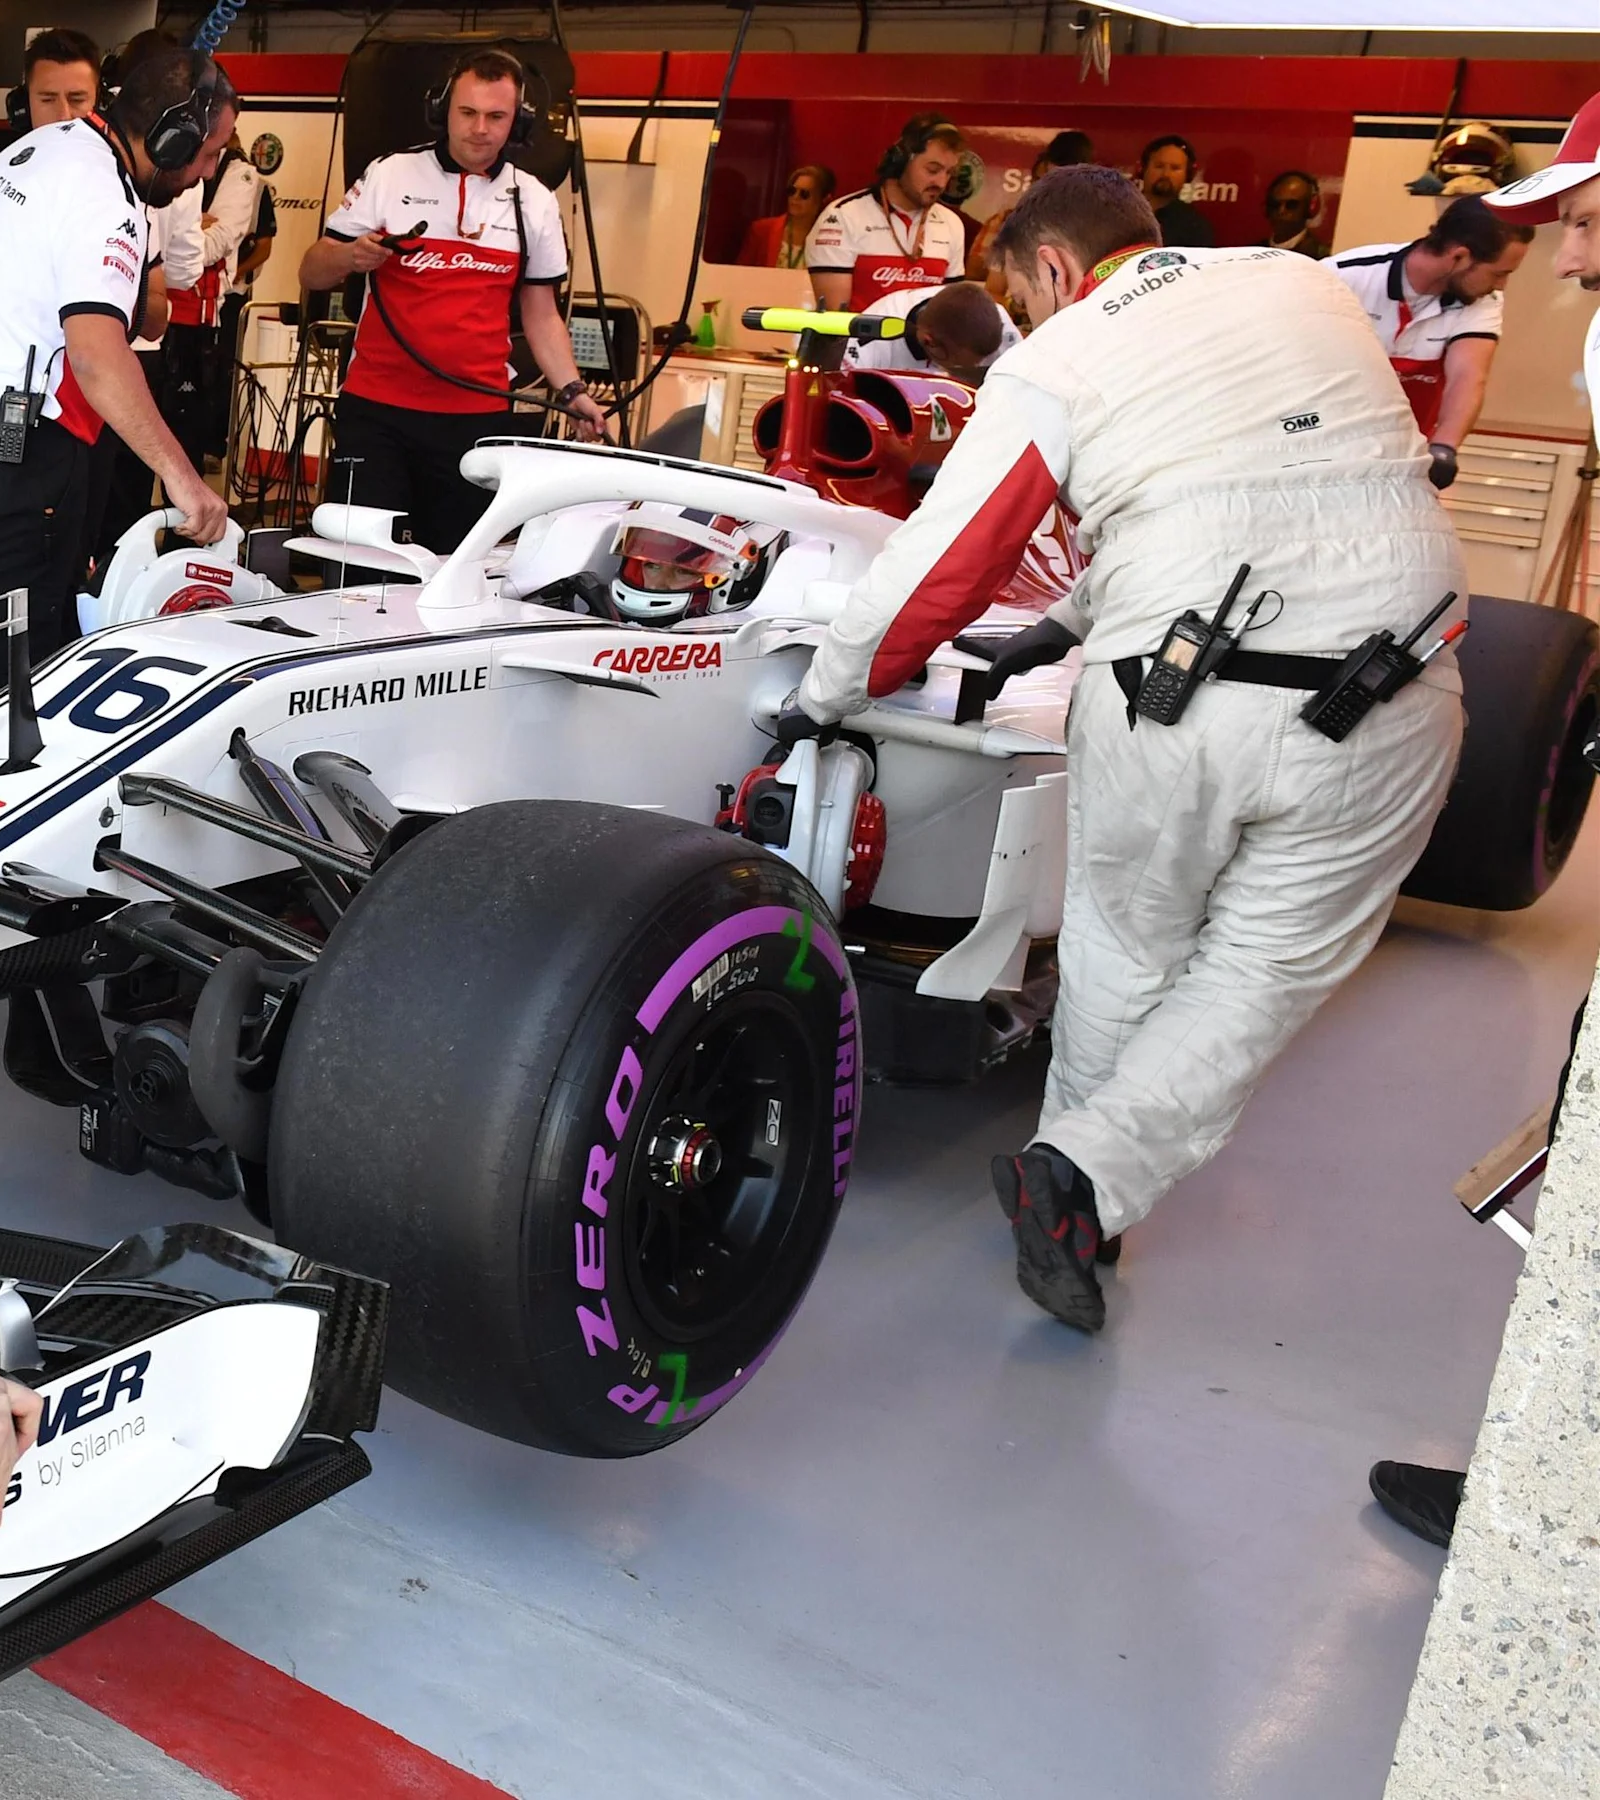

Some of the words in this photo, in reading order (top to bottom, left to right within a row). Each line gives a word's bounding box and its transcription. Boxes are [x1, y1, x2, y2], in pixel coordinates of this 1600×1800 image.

[270, 186, 322, 209] omeo
[1178, 178, 1238, 202] eam
[450, 253, 515, 274] Romeo
[872, 266, 907, 288] Alfa
[1102, 266, 1184, 316] Sauber
[1283, 415, 1320, 432] OMP
[593, 642, 721, 674] CARRERA
[35, 647, 208, 734] 16
[288, 677, 406, 716] RICHARD
[414, 665, 488, 699] MILLE
[574, 1045, 644, 1357] ZERO
[37, 1456, 63, 1487] by
[69, 1415, 146, 1469] Silanna
